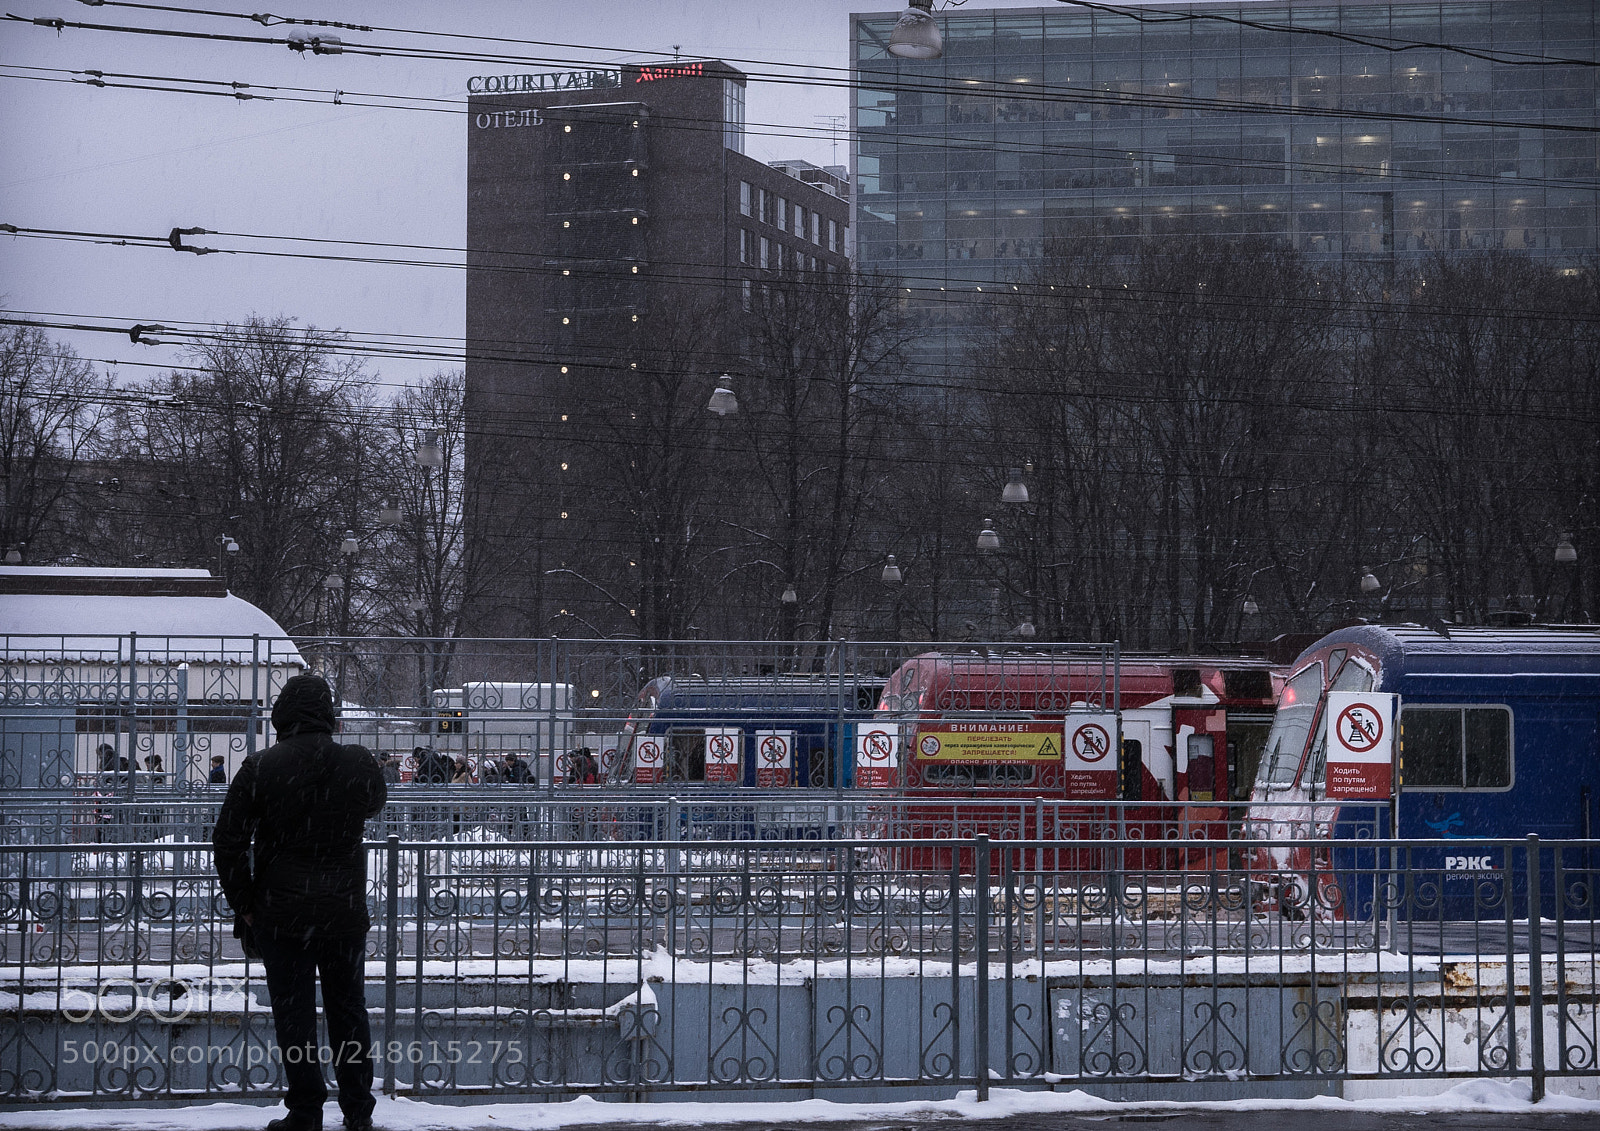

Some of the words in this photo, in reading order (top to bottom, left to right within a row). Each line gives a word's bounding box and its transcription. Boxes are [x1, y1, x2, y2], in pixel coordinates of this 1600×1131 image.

[635, 63, 703, 83] Marriott
[466, 69, 620, 93] COURTYARD
[475, 109, 544, 129] ОТЕЛЬ
[950, 723, 1030, 732] ВНИМАНИЕ!
[1333, 766, 1361, 775] Ходить
[1343, 777, 1366, 785] путям
[1332, 785, 1377, 794] запрещено!
[1445, 872, 1475, 882] регион
